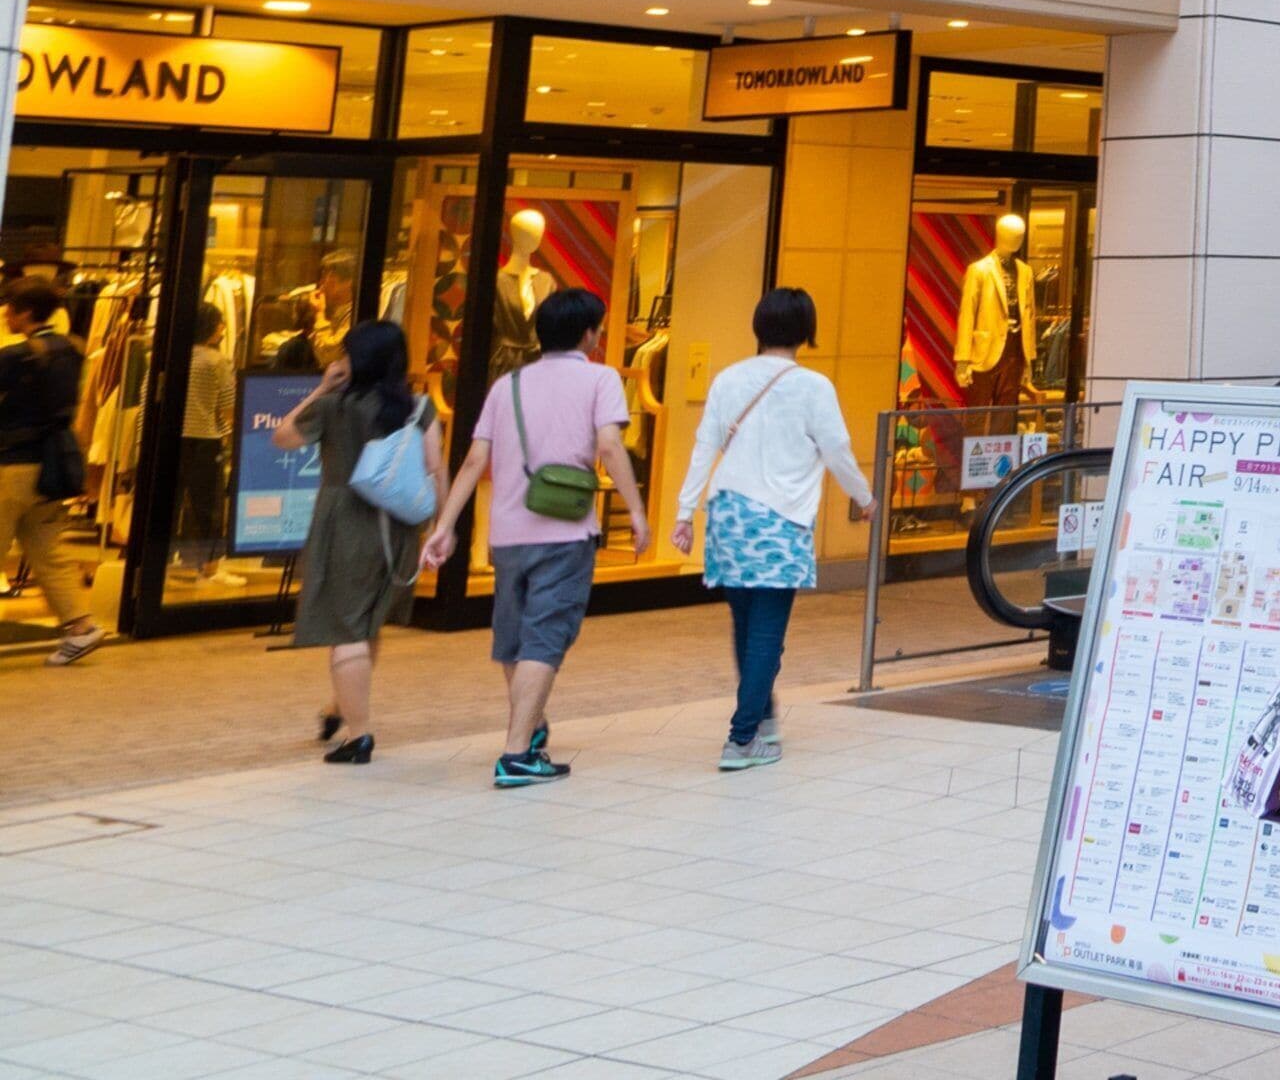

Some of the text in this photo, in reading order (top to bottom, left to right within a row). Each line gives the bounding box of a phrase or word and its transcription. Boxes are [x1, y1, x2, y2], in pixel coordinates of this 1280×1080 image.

[735, 63, 866, 91] TOMORROWLAND
[1148, 426, 1245, 456] HAPPY
[1142, 460, 1207, 489] FAIR
[1233, 475, 1262, 494] 9/14
[1073, 948, 1105, 963] OUTLET
[1106, 954, 1127, 966] PARK
